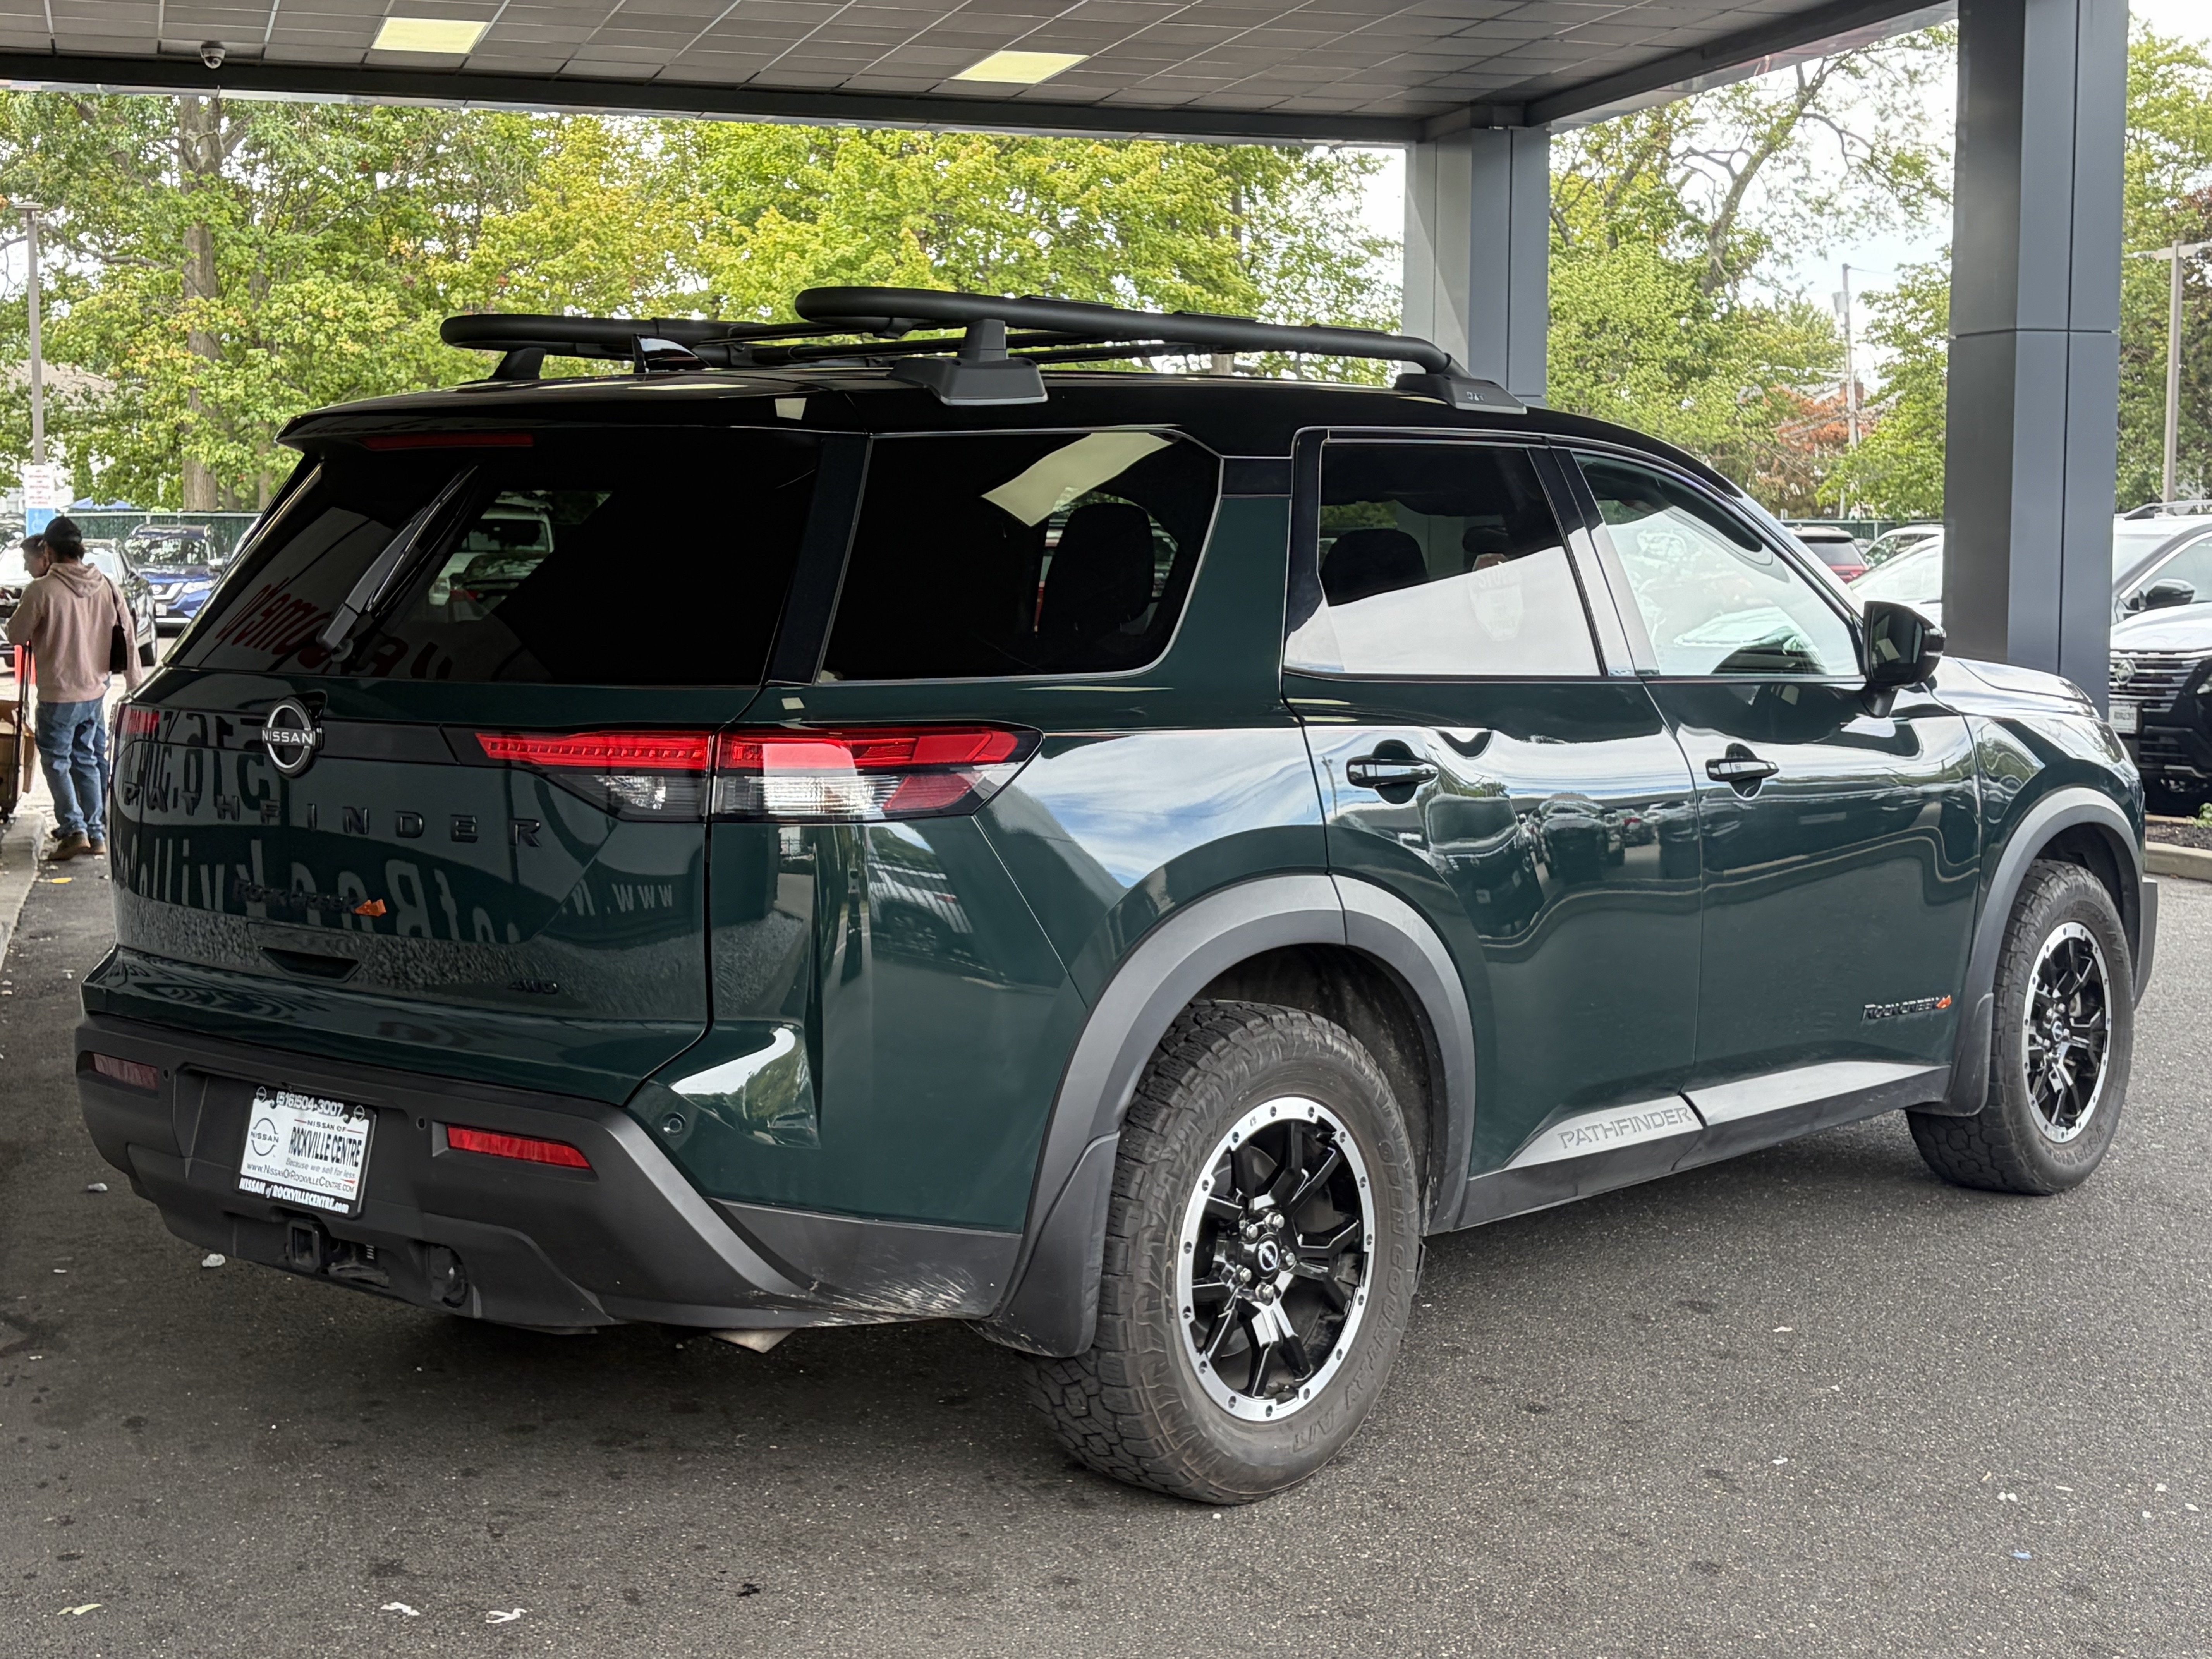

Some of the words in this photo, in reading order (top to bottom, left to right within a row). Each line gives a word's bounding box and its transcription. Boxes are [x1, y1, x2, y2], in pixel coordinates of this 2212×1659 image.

[262, 729, 313, 744] NISSAN
[124, 781, 541, 848] PATHFINDER
[507, 979, 559, 995] 4WD
[276, 1090, 344, 1117] (516)504-3007
[251, 1131, 279, 1143] NISSAN
[307, 1120, 335, 1131] NISSAN
[336, 1124, 347, 1132] OF
[1557, 1106, 1693, 1149] PATHFINDER
[288, 1126, 331, 1161] ROCKVILLE
[331, 1134, 362, 1167] CENTRE
[285, 1157, 309, 1170] Because
[310, 1163, 321, 1172] we
[333, 1168, 343, 1176] for
[239, 1177, 266, 1195] NISSAN
[1377, 1140, 1406, 1237] OPEN
[1345, 1244, 1405, 1411] COUNTRY
[1293, 1407, 1334, 1453] A/T
